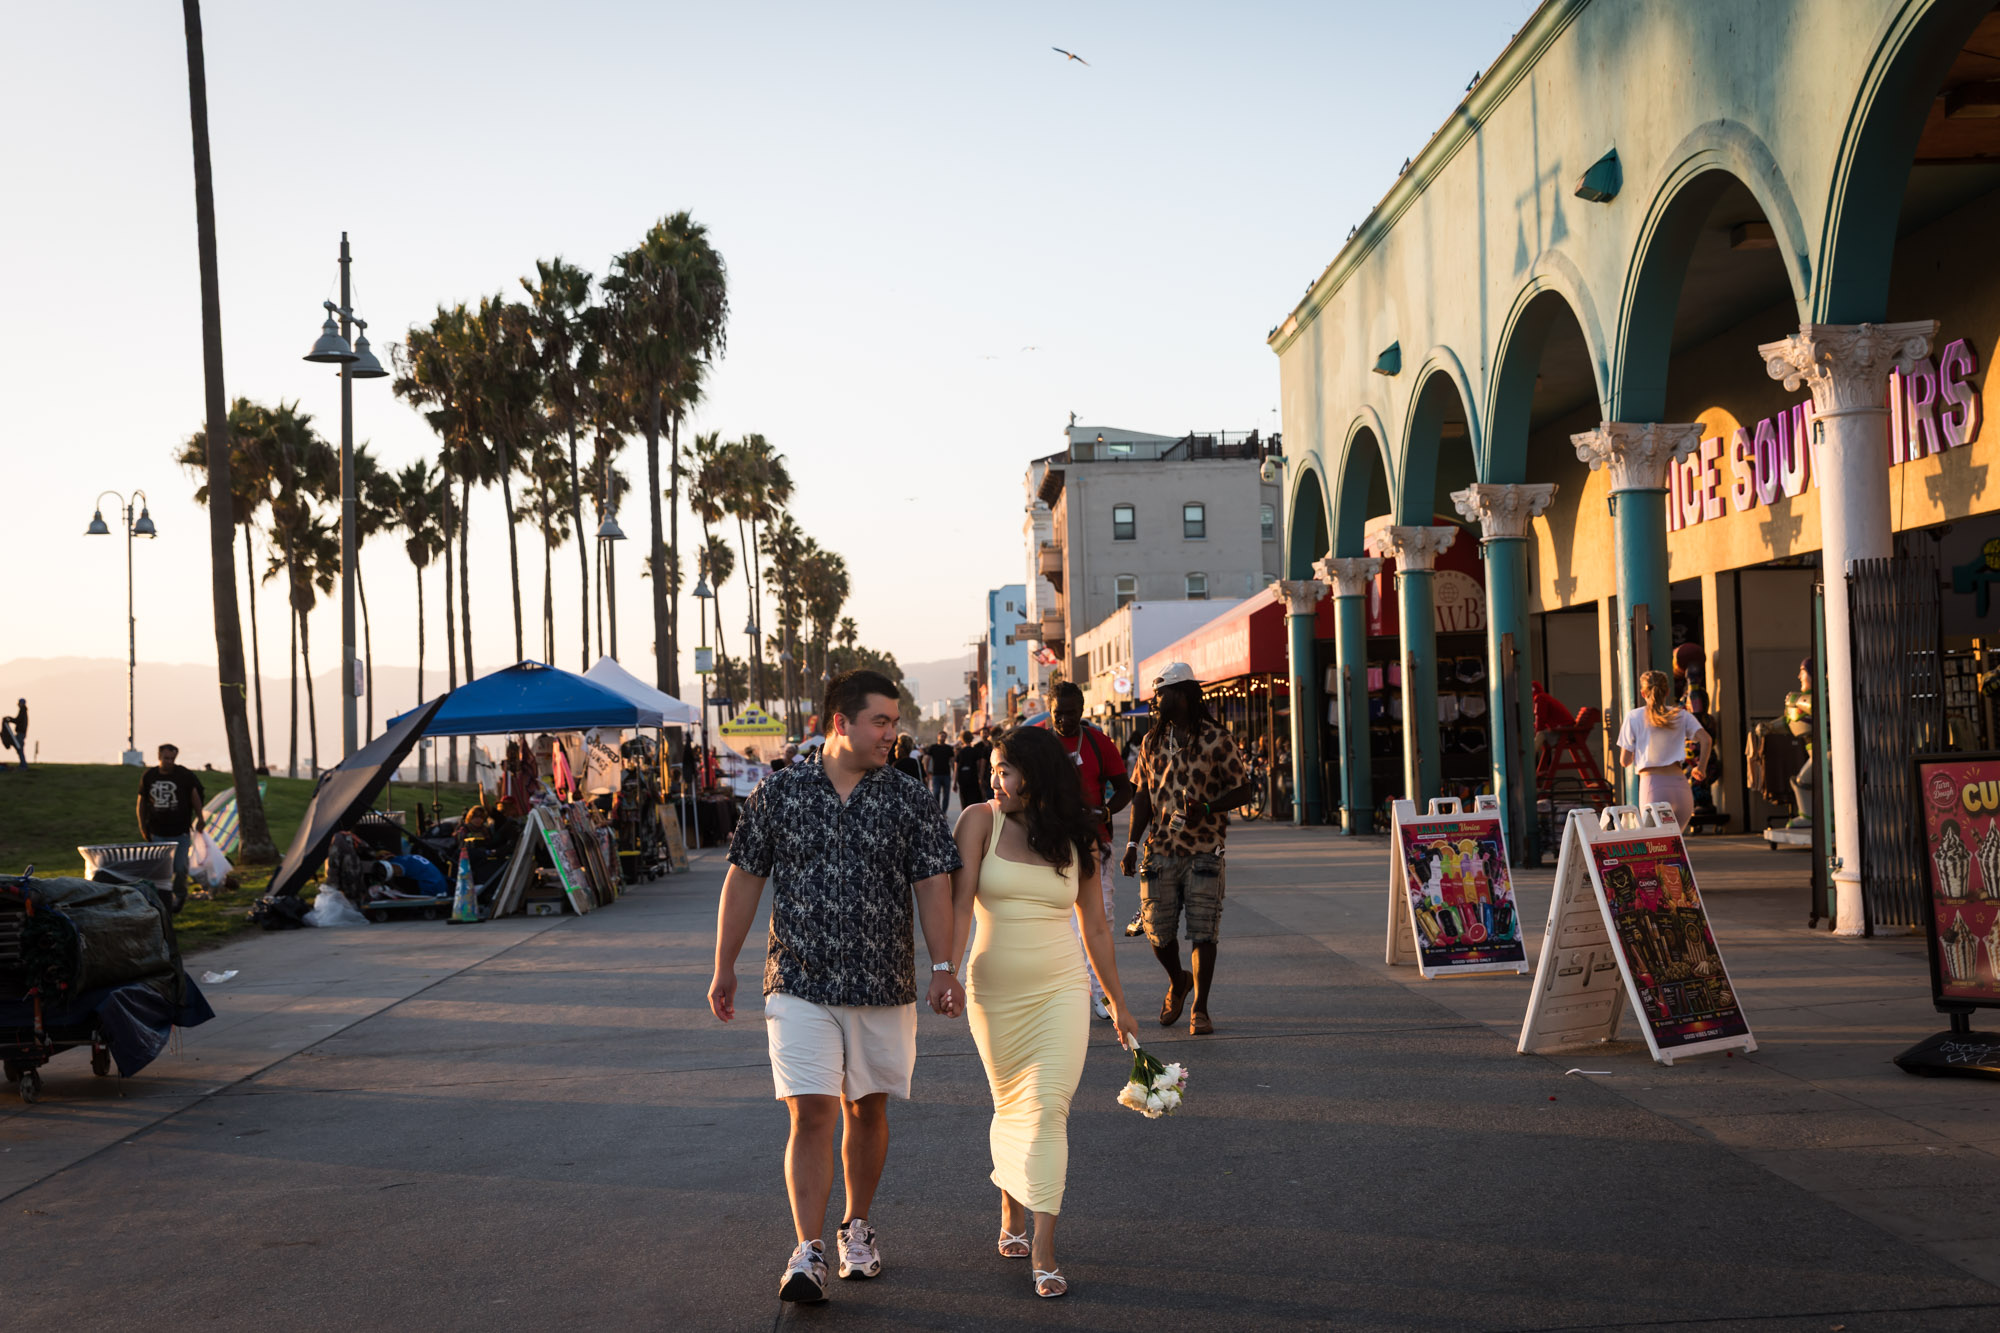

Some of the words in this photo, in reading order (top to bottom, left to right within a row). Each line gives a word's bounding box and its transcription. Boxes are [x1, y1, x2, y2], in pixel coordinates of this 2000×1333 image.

[1666, 437, 1727, 533] ICE
[1962, 780, 2000, 812] CU
[1417, 824, 1437, 835] LALA
[1438, 823, 1459, 834] LAND
[1459, 822, 1481, 832] Venice
[1607, 844, 1628, 858] LALA
[1627, 842, 1647, 856] LAND
[1646, 841, 1668, 854] Venice
[1683, 1032, 1696, 1040] GOOD
